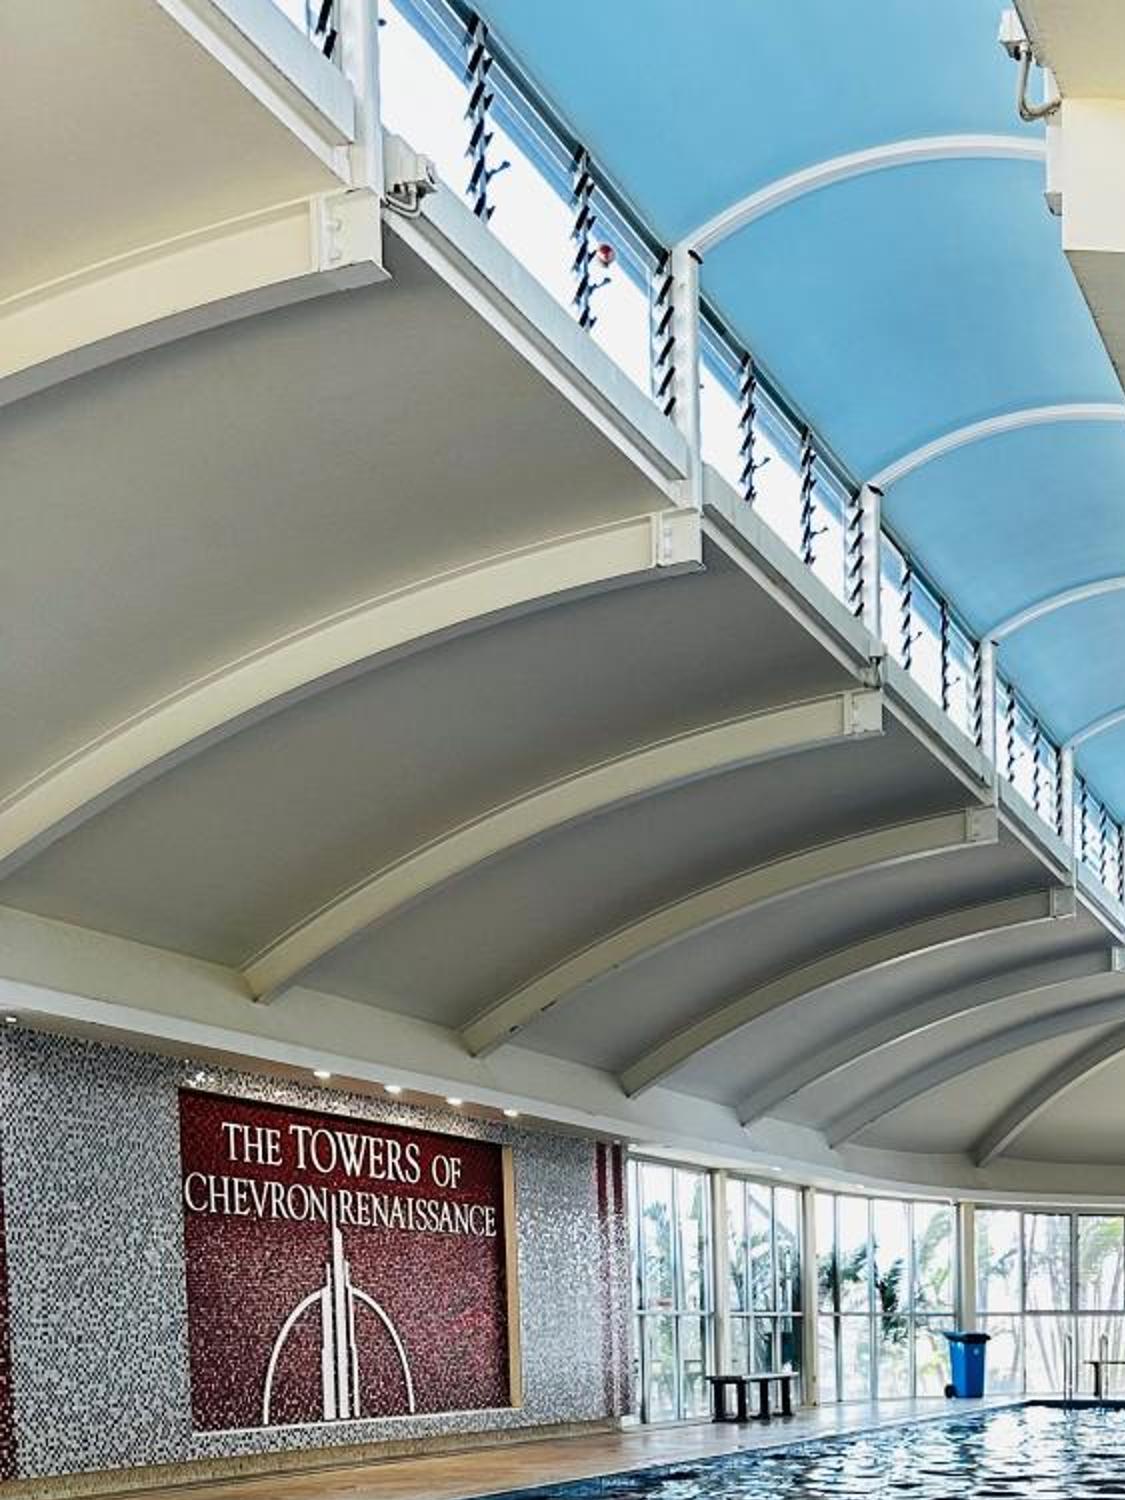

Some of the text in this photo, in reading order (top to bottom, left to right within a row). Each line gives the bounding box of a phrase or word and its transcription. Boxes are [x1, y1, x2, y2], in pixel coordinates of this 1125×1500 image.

[221, 1121, 462, 1189] THE TOWERS OF
[184, 1171, 497, 1237] CHEVRON RENAISSANCE
